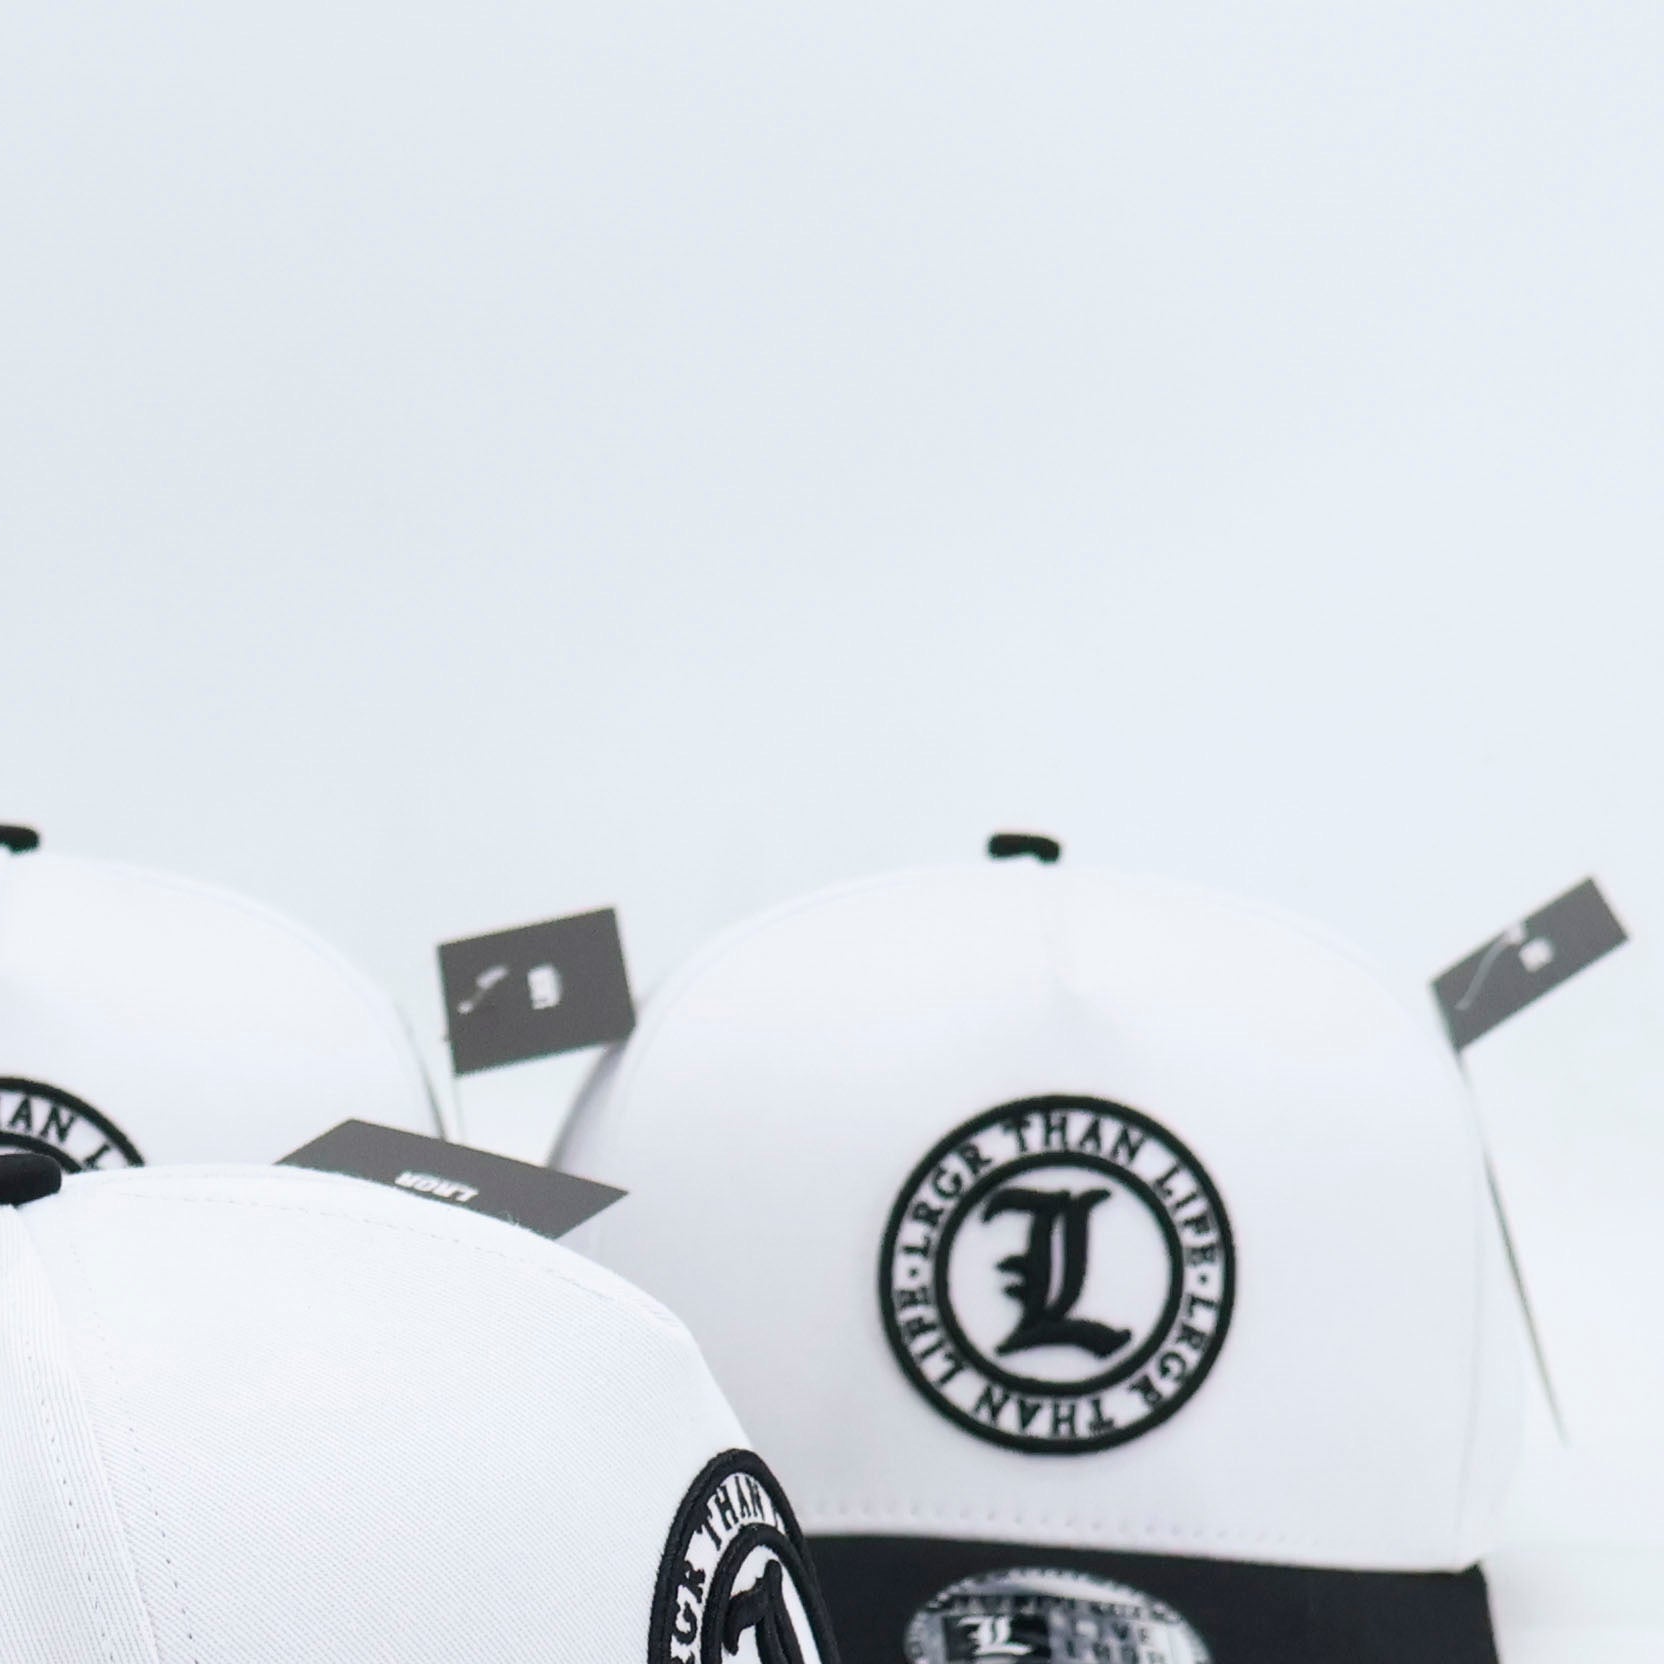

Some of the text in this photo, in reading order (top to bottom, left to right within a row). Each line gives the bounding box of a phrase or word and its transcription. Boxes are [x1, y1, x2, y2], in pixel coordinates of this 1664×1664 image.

[902, 1111, 1220, 1266] LRGR THAN LIFE
[1129, 1293, 1215, 1405] LRGR
[976, 1382, 1114, 1437] THAN
[694, 1475, 766, 1551] THAN
